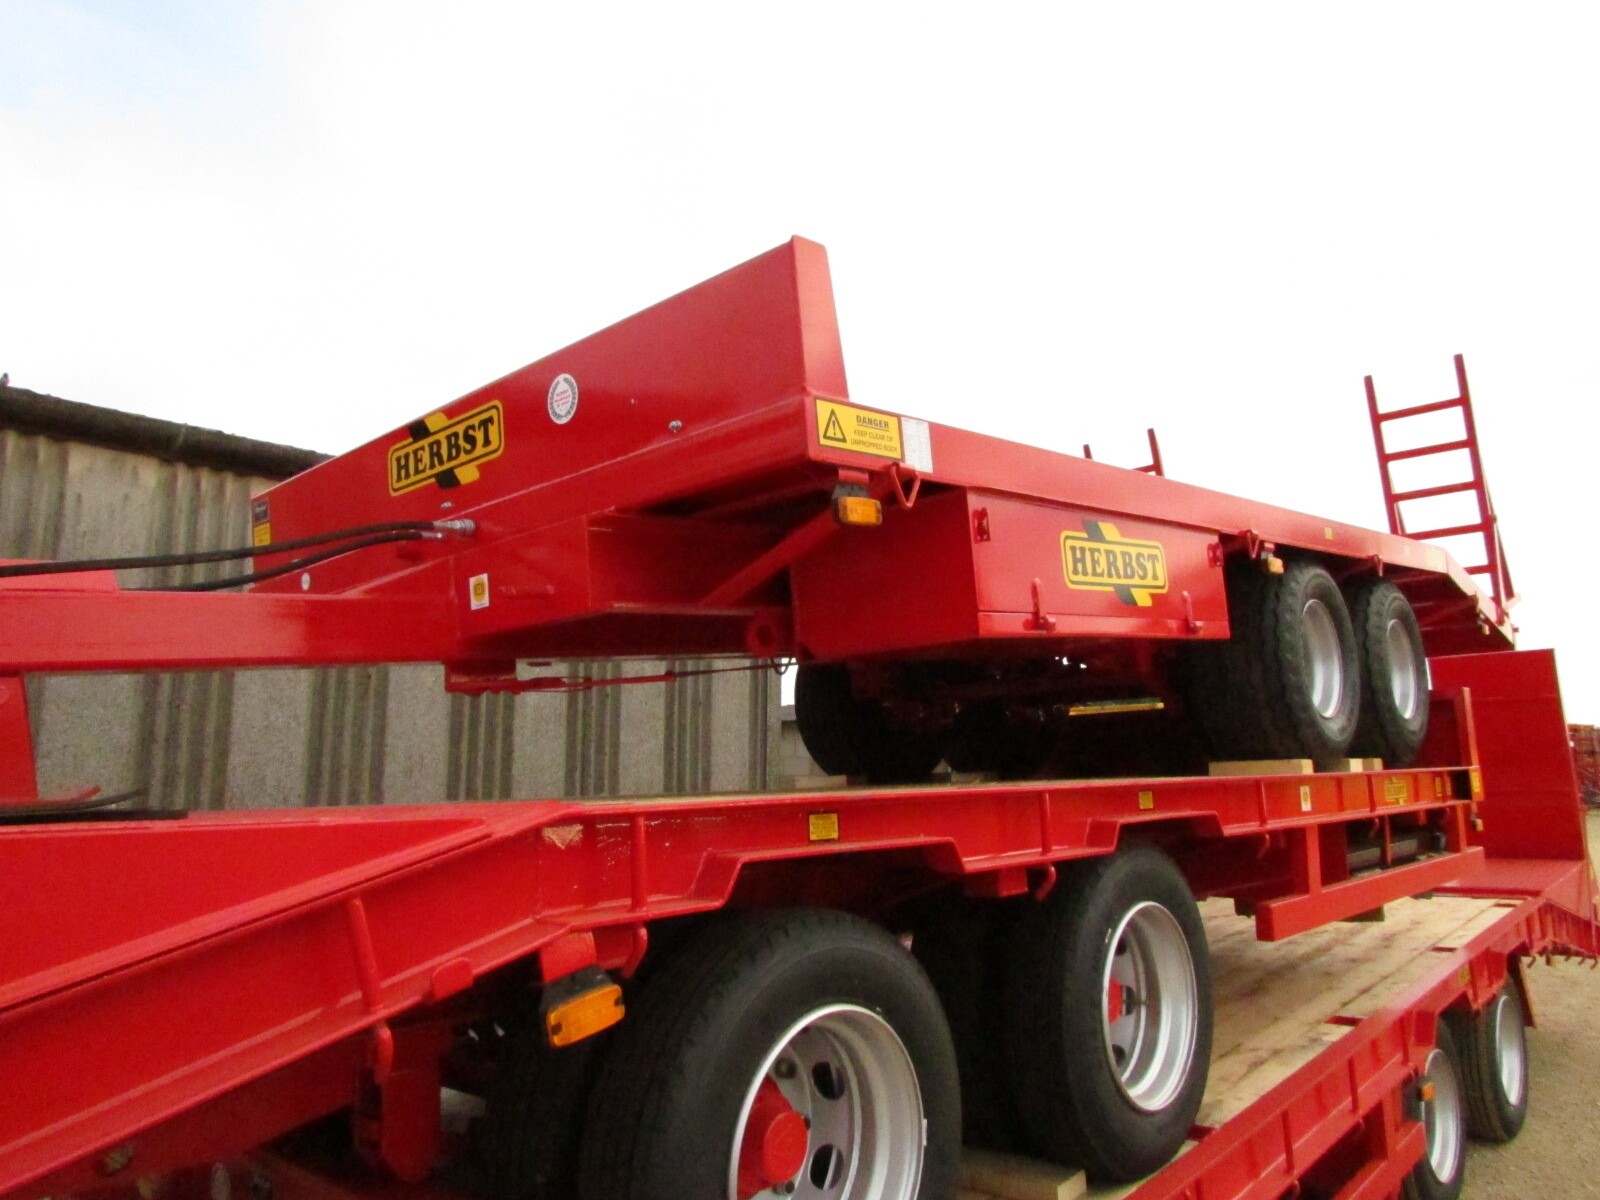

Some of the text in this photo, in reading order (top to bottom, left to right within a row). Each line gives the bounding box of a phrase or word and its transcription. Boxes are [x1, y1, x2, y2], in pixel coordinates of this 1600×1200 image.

[856, 414, 890, 430] DANGER
[853, 429, 868, 438] KEEP
[868, 431, 886, 441] CLEAR
[395, 415, 495, 484] HERBST
[850, 438, 883, 450] UNPROPPED
[1069, 545, 1160, 581] HERBST
